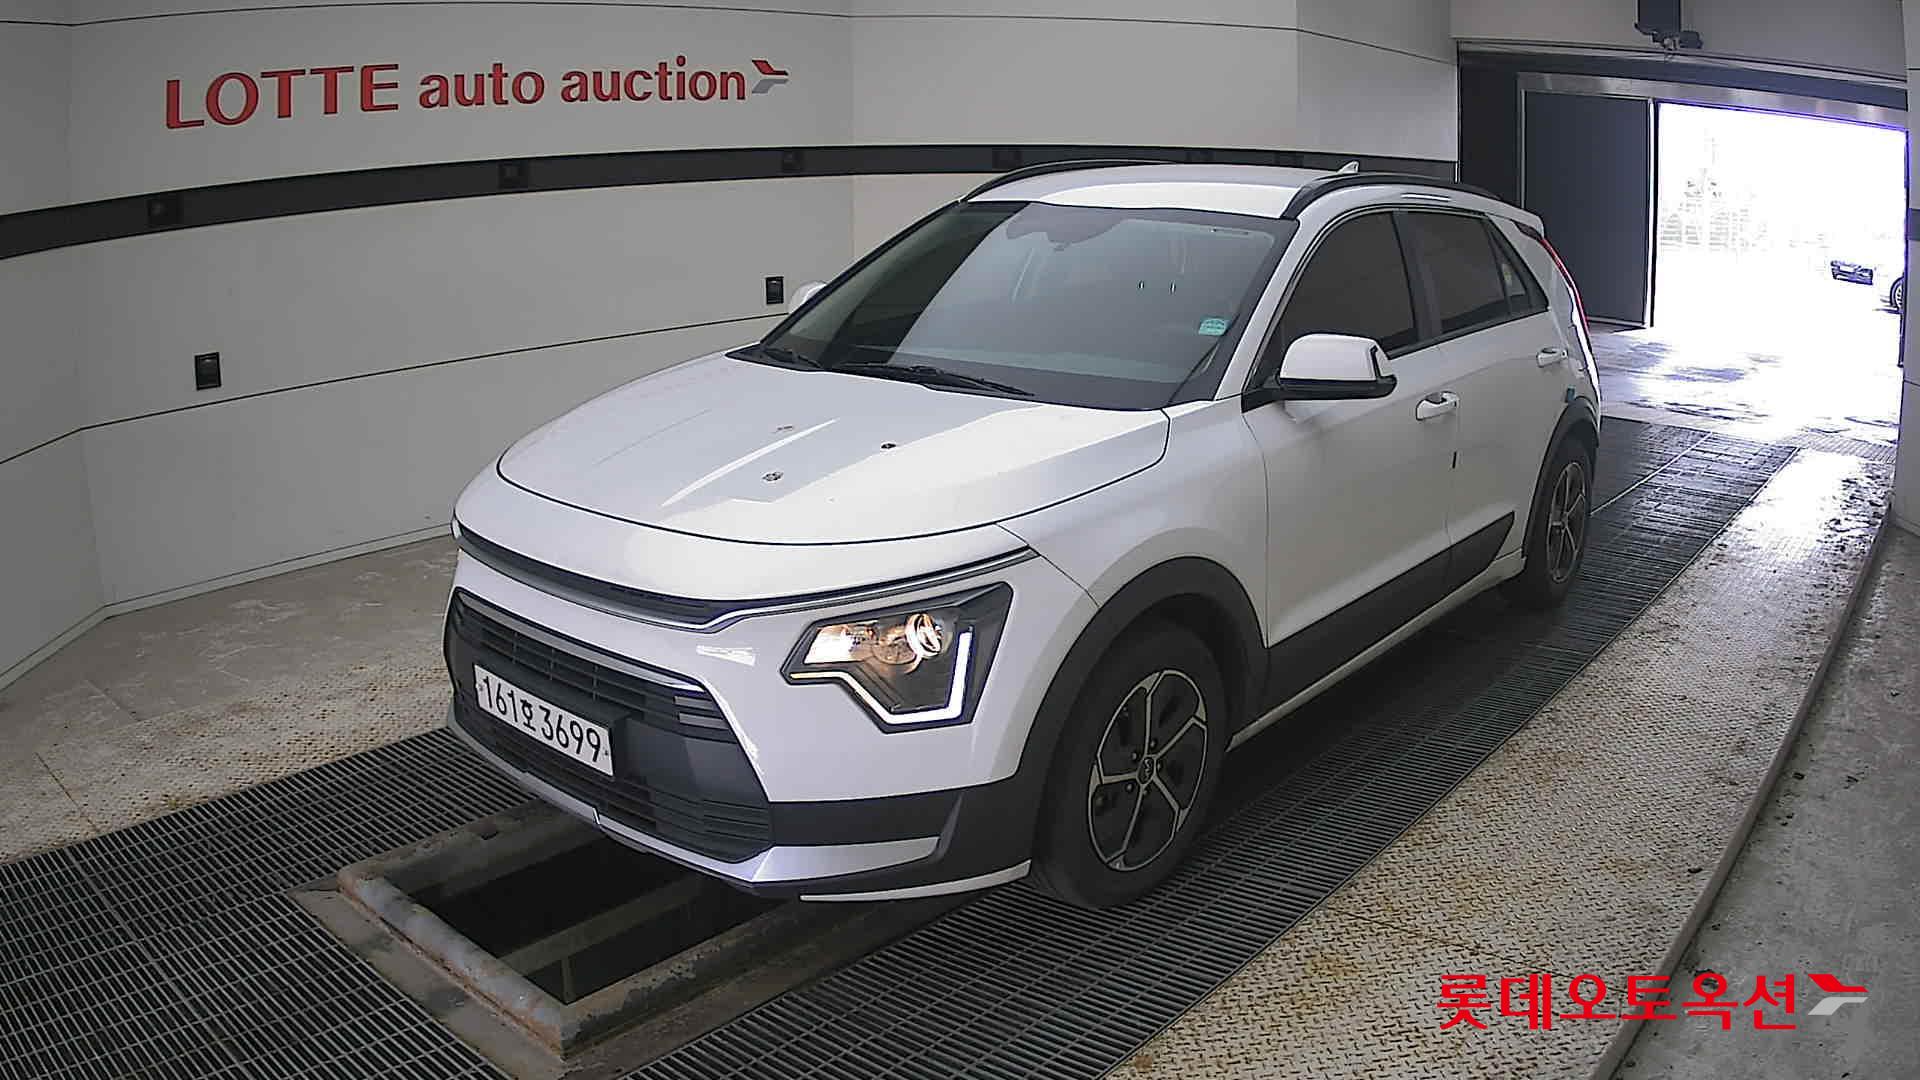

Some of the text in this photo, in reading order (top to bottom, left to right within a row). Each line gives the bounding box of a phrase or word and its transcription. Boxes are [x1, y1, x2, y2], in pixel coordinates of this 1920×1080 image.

[166, 55, 746, 130] LOTTE auto auction
